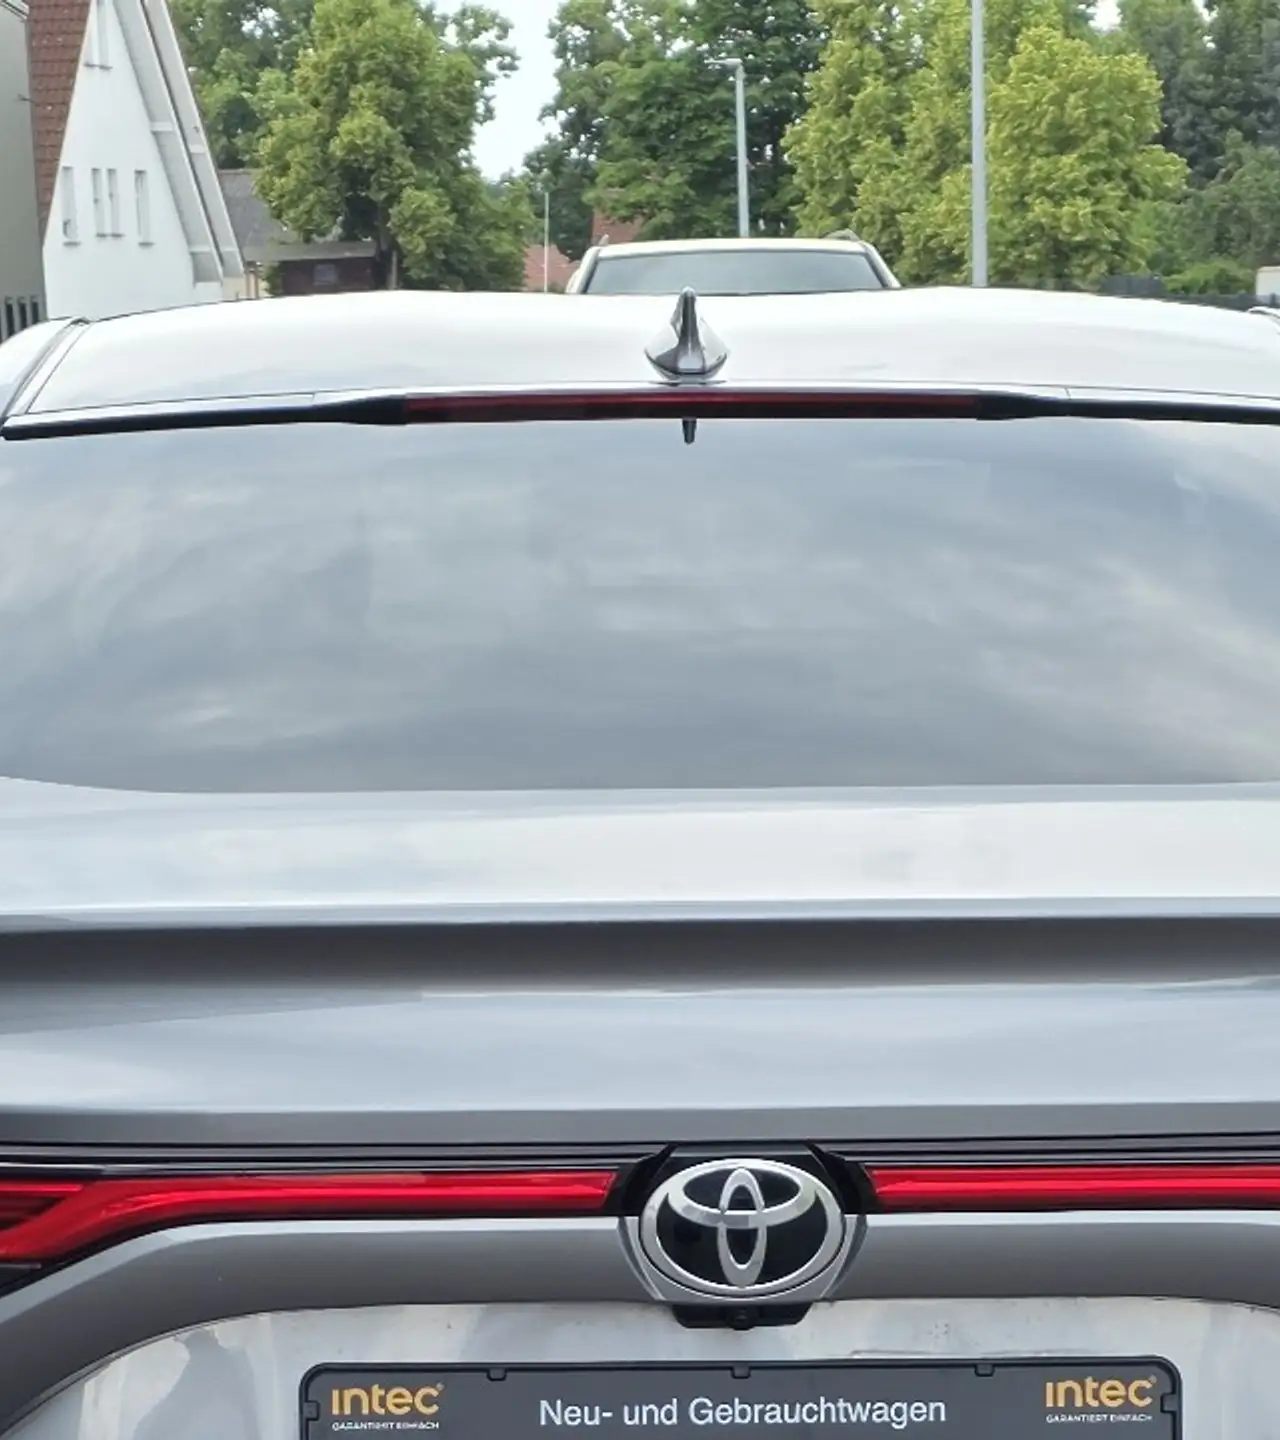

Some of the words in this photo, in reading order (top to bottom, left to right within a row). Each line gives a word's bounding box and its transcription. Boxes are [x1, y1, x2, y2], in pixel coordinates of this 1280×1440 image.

[539, 1399, 613, 1427] Neu-
[623, 1398, 678, 1426] und
[688, 1396, 947, 1429] Gebrauchtwagen
